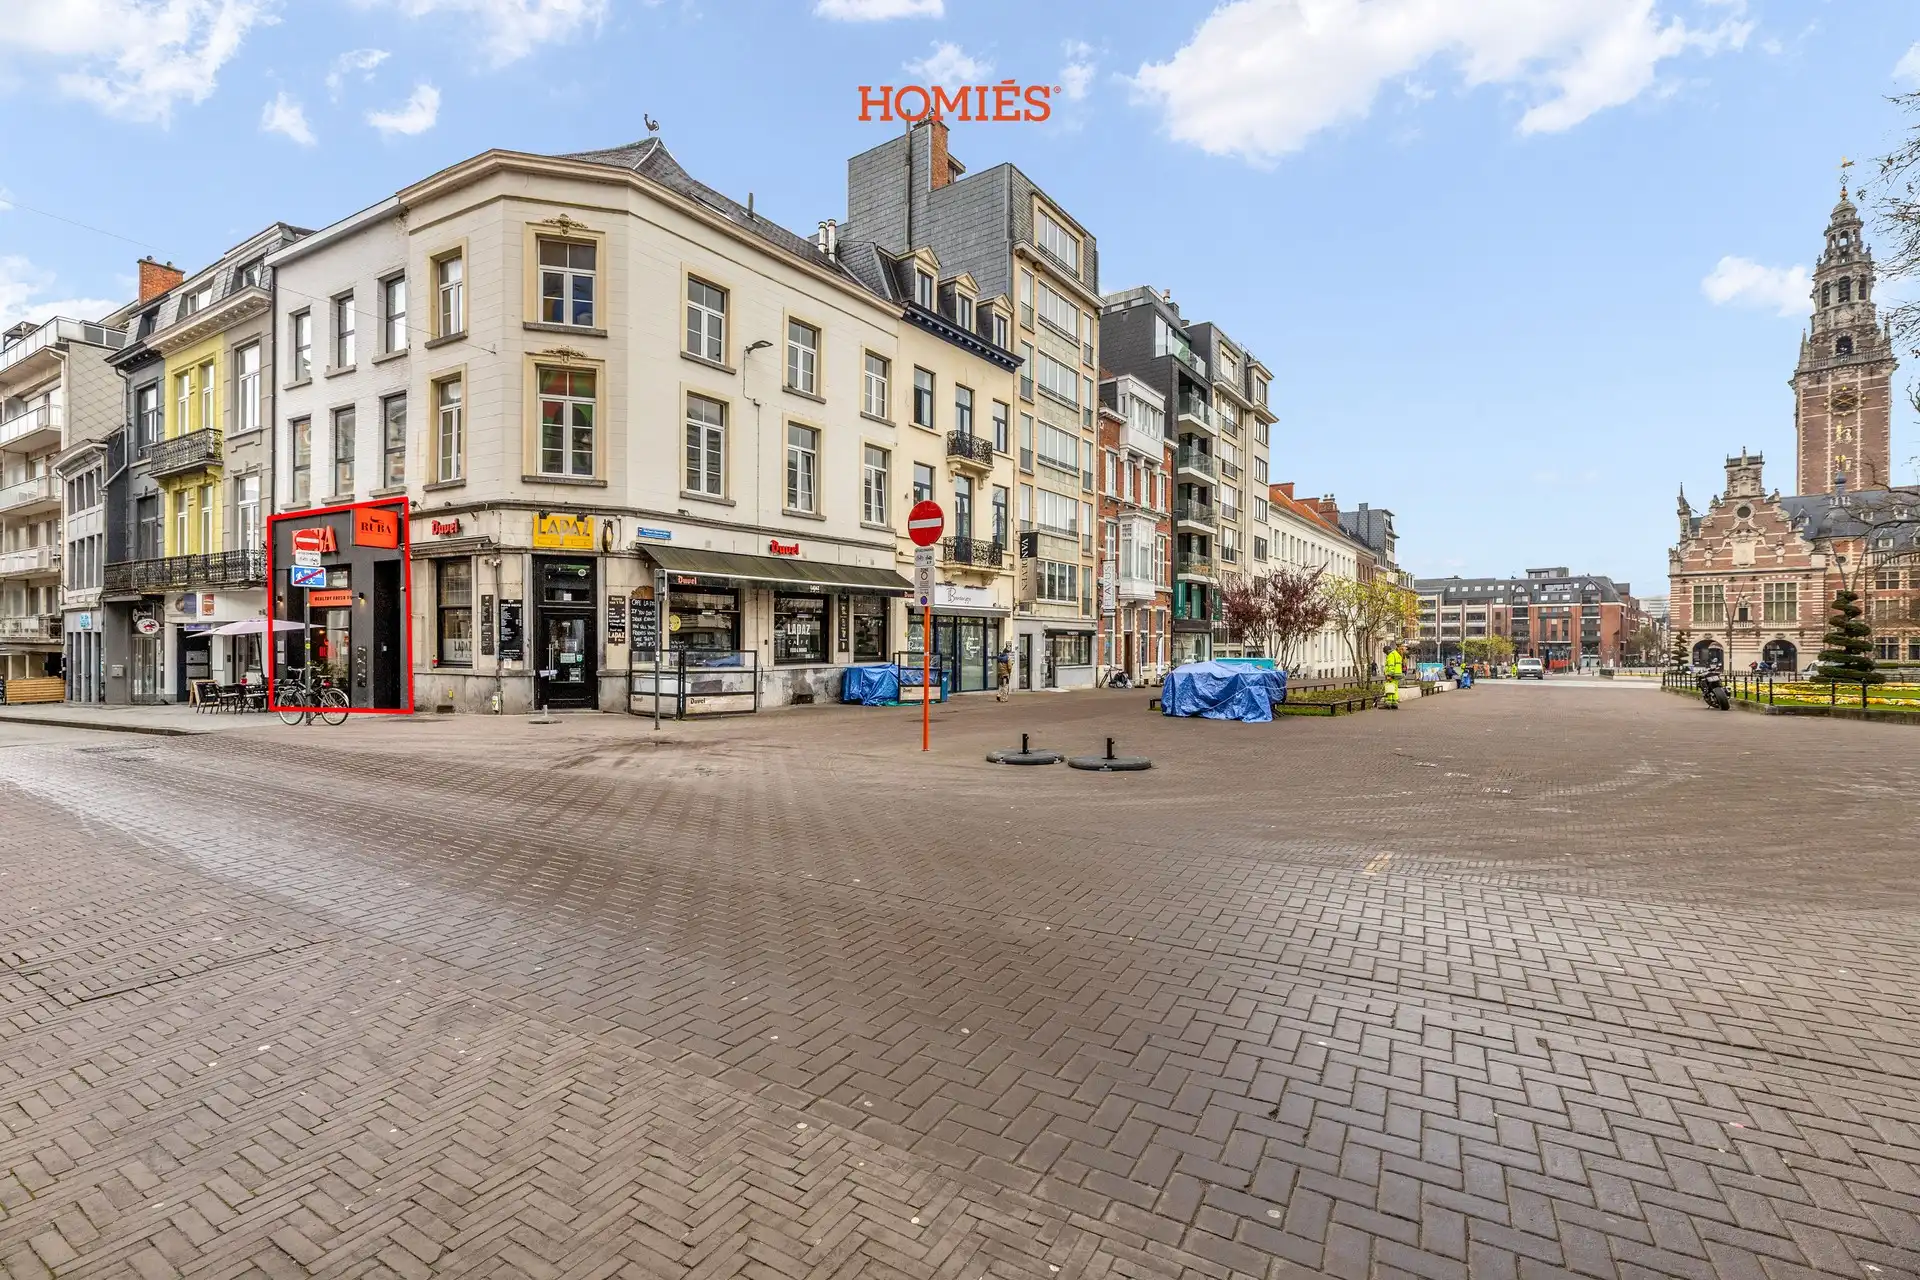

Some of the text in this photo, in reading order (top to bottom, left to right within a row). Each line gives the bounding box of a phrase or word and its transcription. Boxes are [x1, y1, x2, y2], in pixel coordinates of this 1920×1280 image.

[360, 521, 392, 534] RUBA
[431, 519, 459, 536] Duvel
[770, 539, 800, 555] Duvel
[677, 575, 697, 584] Duvel
[787, 623, 811, 646] LAPAZ
[690, 697, 706, 705] Duvel
